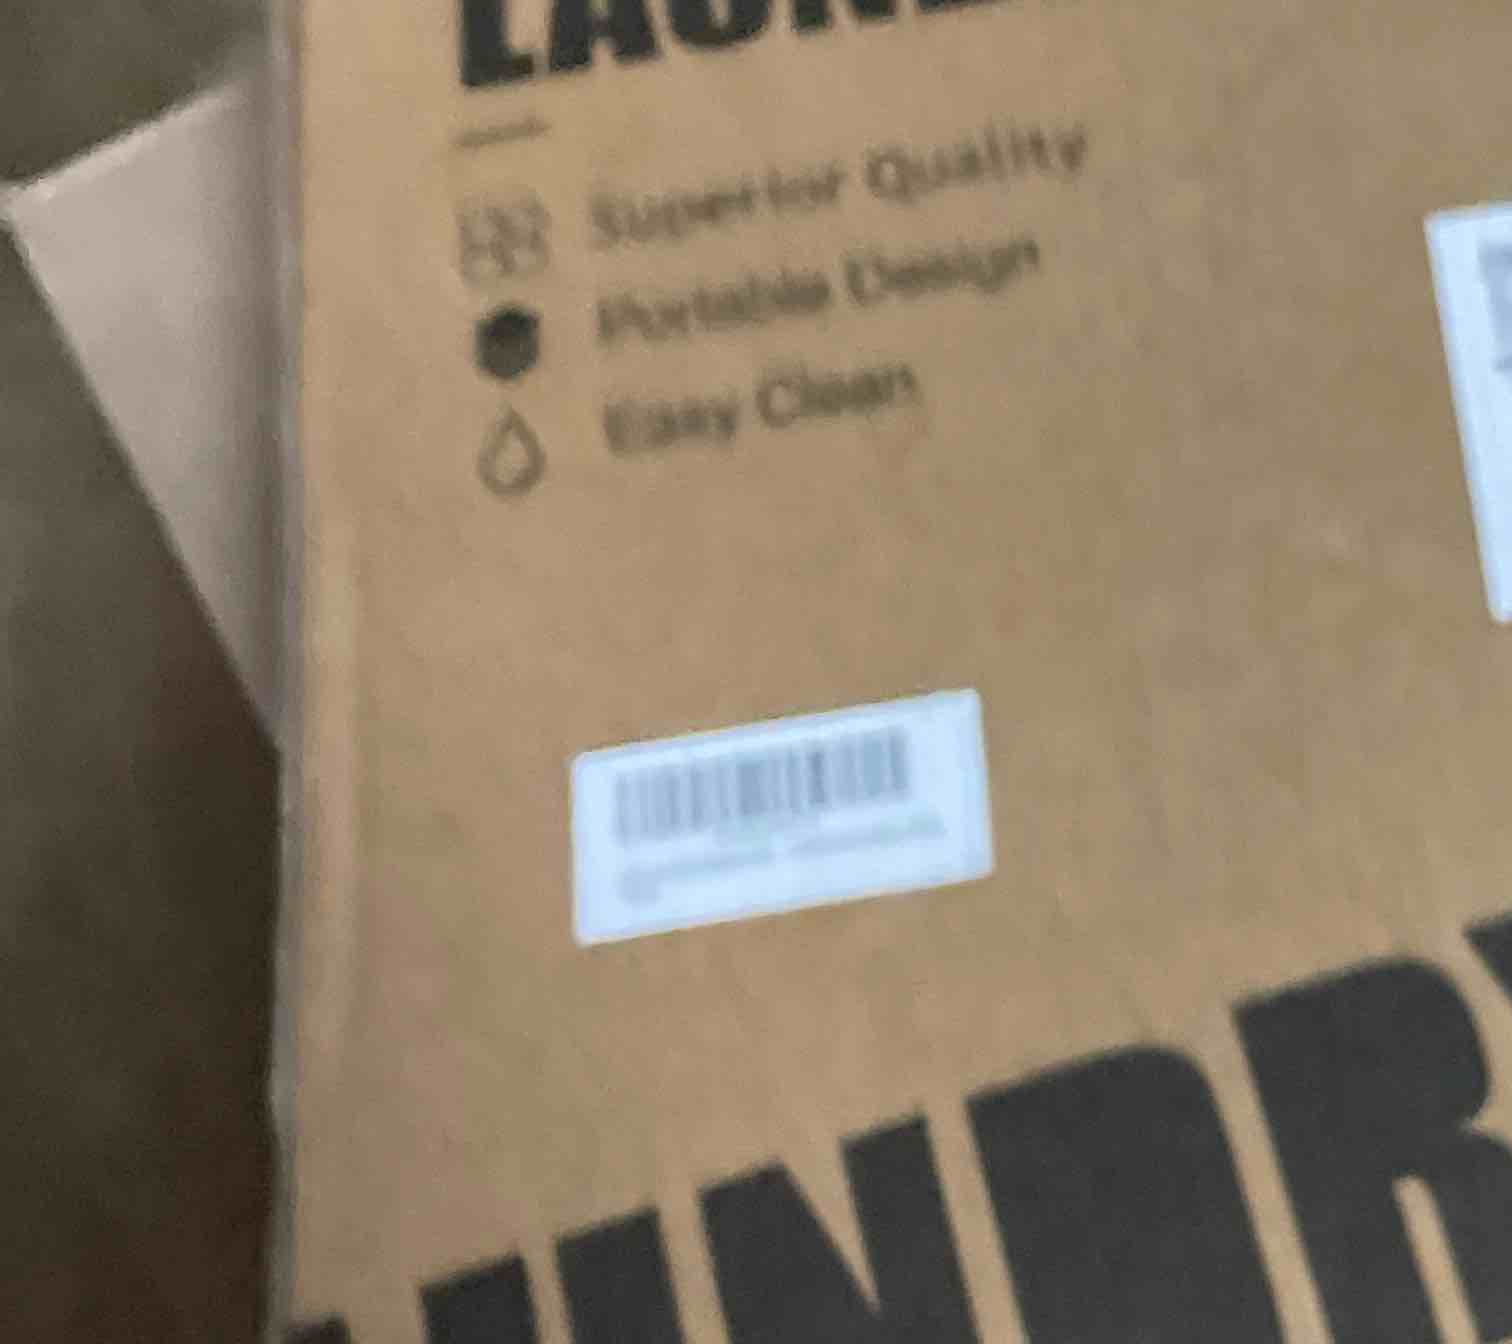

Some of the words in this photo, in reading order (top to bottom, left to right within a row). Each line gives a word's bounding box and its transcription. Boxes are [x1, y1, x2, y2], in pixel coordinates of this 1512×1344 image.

[590, 168, 844, 250] Superior
[864, 120, 1087, 202] Quality
[598, 270, 832, 346] Portable
[842, 234, 1041, 306] Design
[603, 394, 740, 458] Easy
[755, 358, 918, 430] Clean
